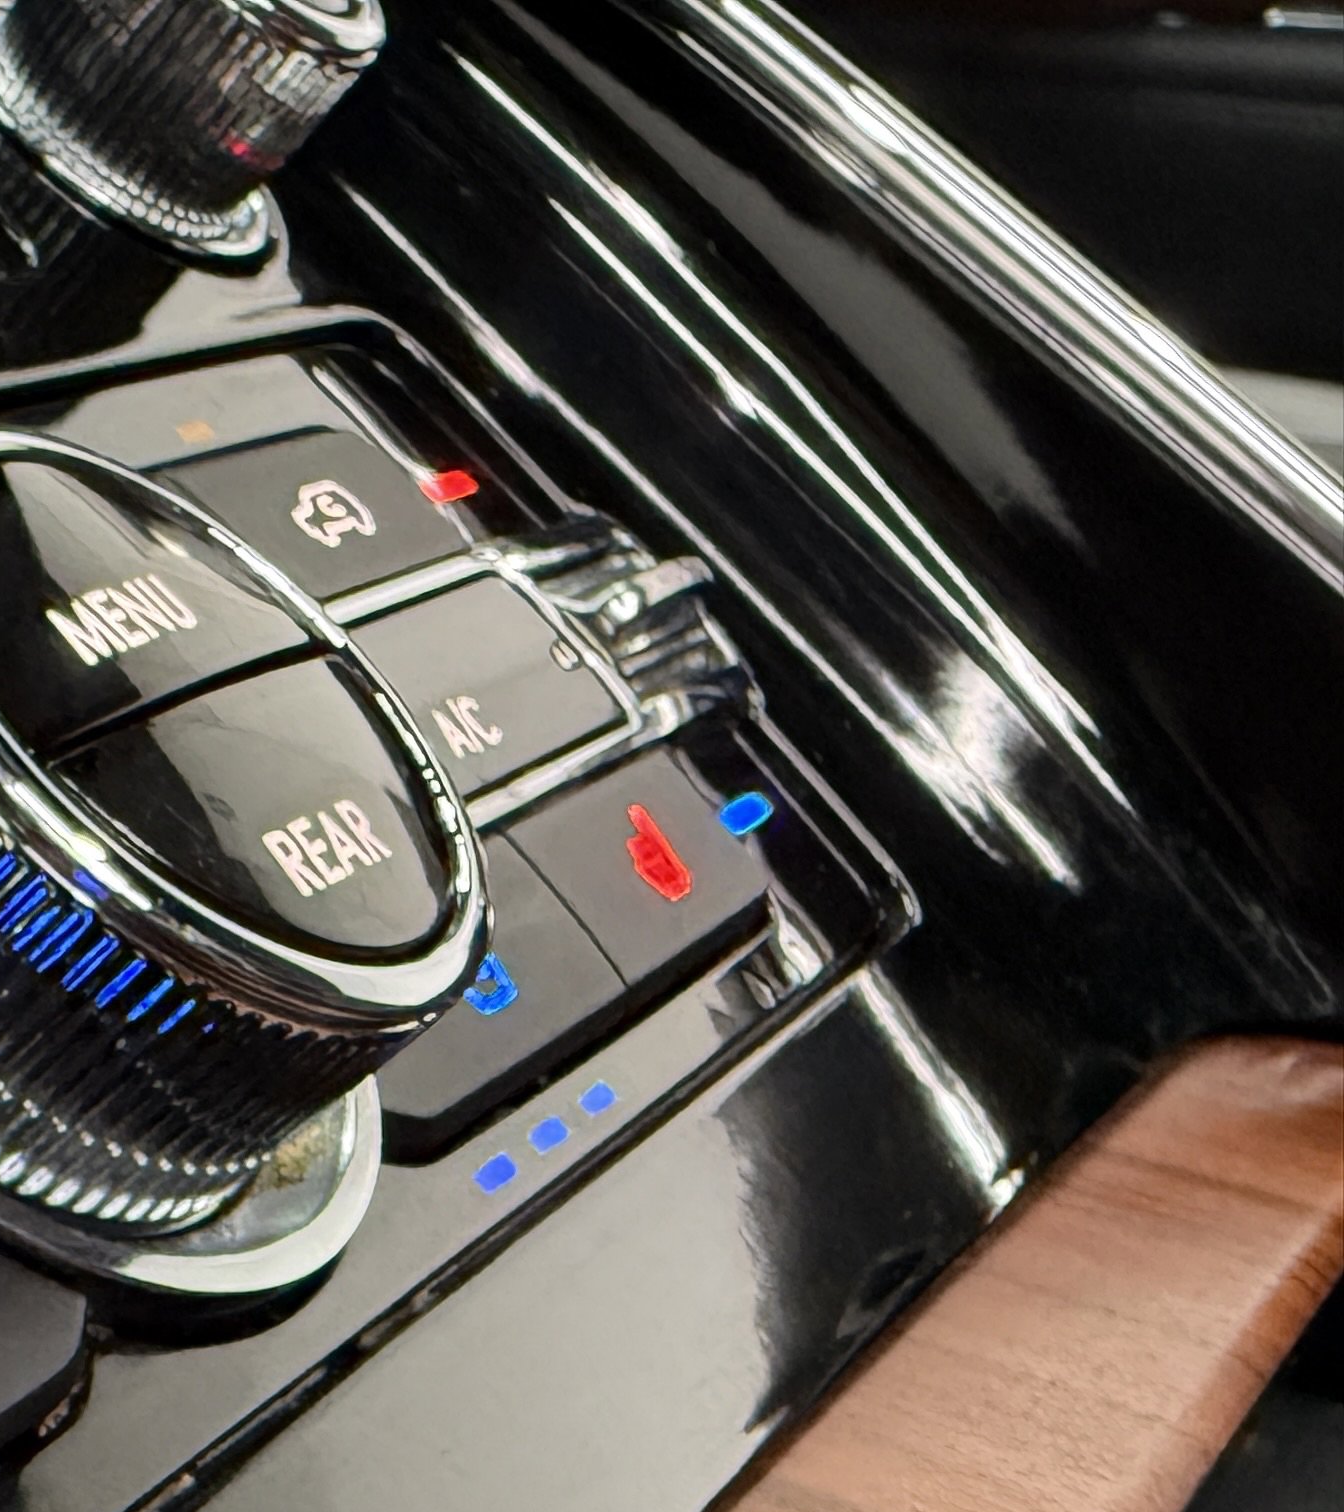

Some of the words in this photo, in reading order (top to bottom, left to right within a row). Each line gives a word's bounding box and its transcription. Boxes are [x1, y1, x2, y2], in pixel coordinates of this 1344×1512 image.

[45, 573, 198, 667] MENU
[431, 695, 503, 760] A/C
[261, 799, 393, 898] REAR
